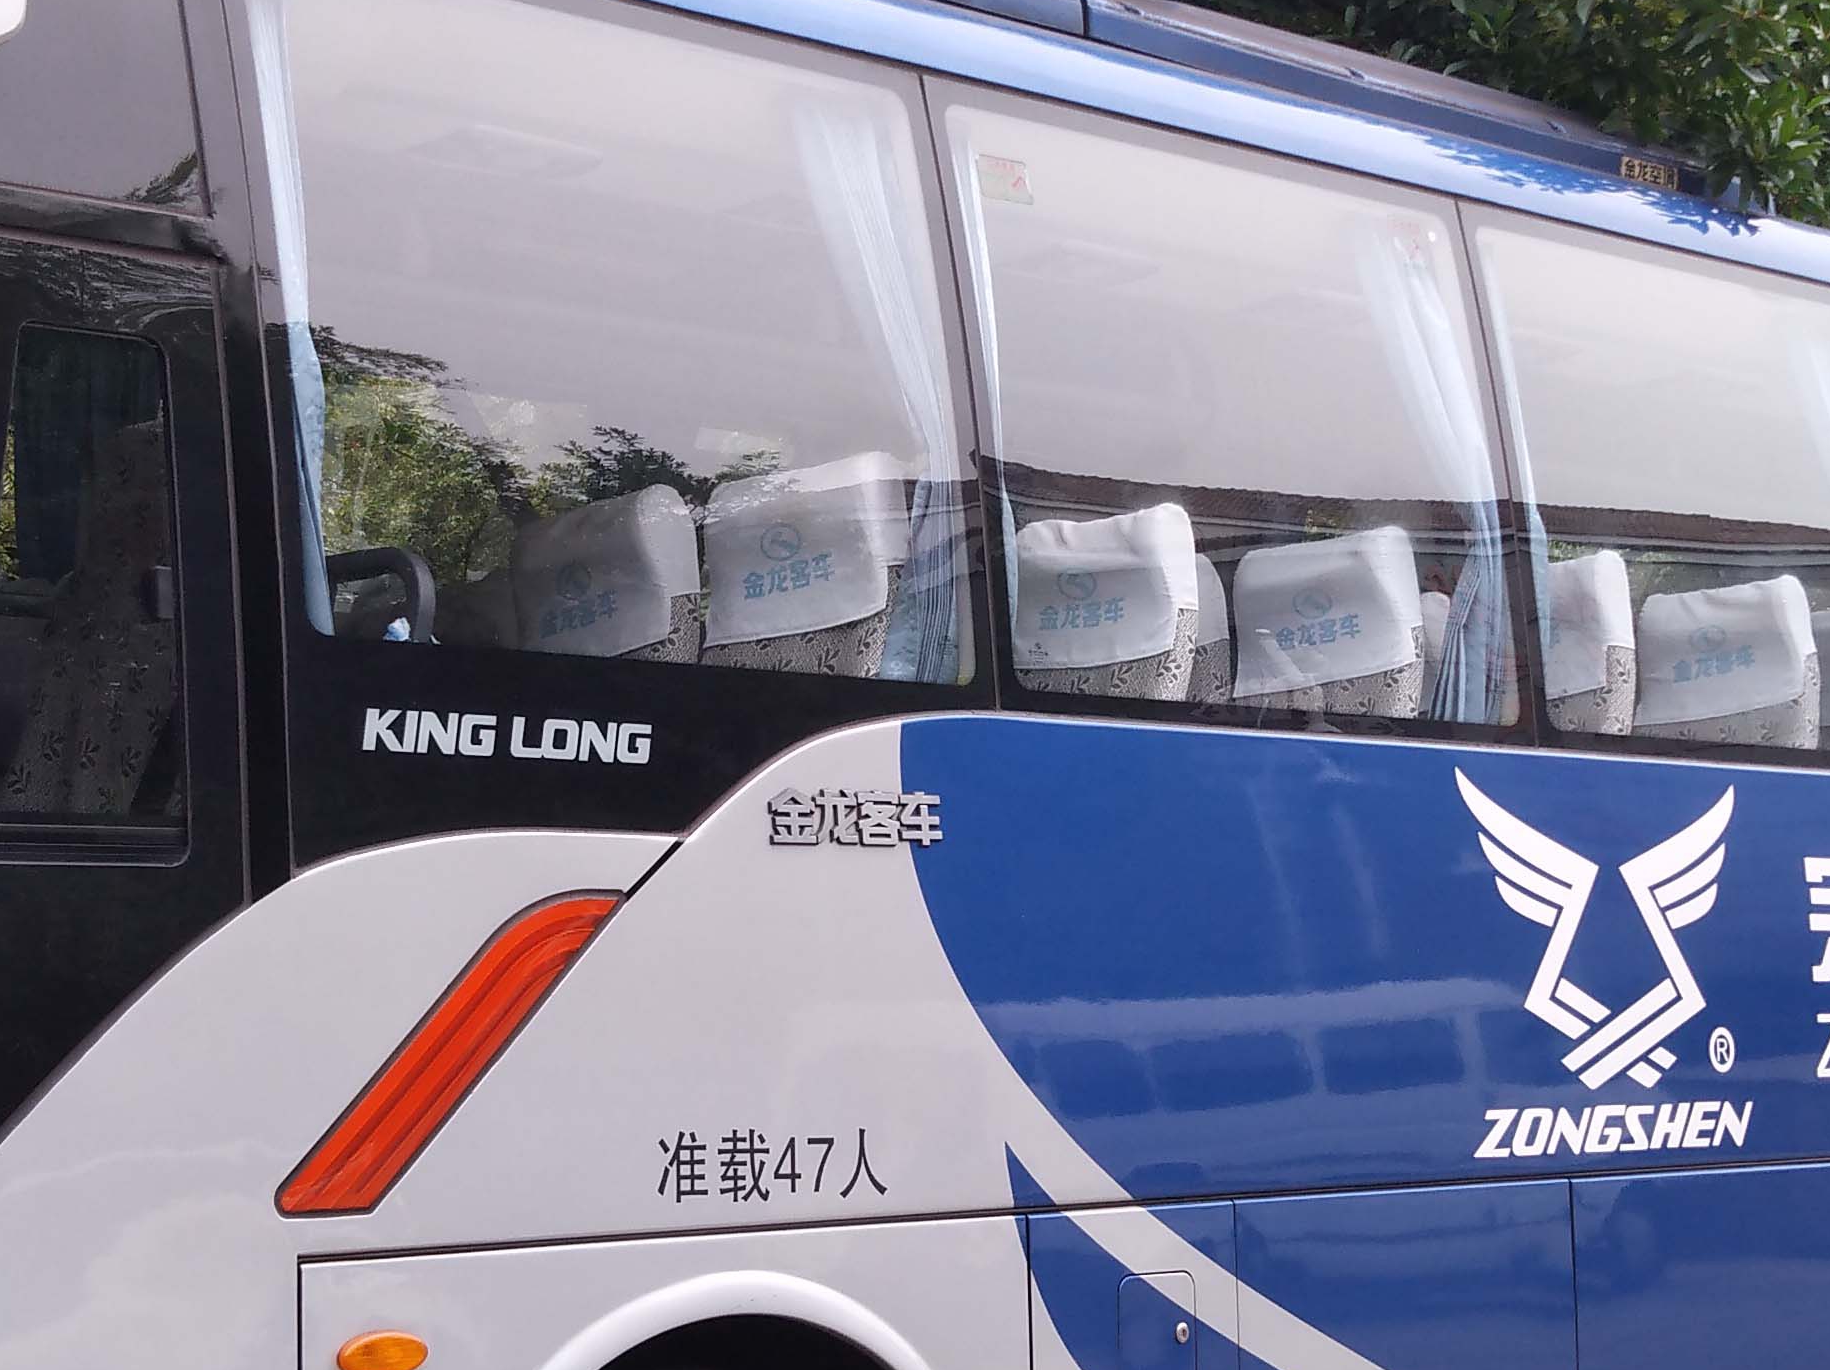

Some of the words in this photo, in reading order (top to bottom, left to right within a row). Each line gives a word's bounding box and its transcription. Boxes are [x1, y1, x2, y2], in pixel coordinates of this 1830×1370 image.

[743, 554, 835, 600] 金龙客车
[1038, 596, 1125, 630] 金龙客车
[362, 708, 497, 758] KING
[510, 716, 652, 765] LONG
[768, 787, 944, 847] 金龙客车
[484, 854, 573, 897] 金龙客车
[1473, 1100, 1754, 1159] ZONGSHEN
[657, 1127, 889, 1204] 准载47人
